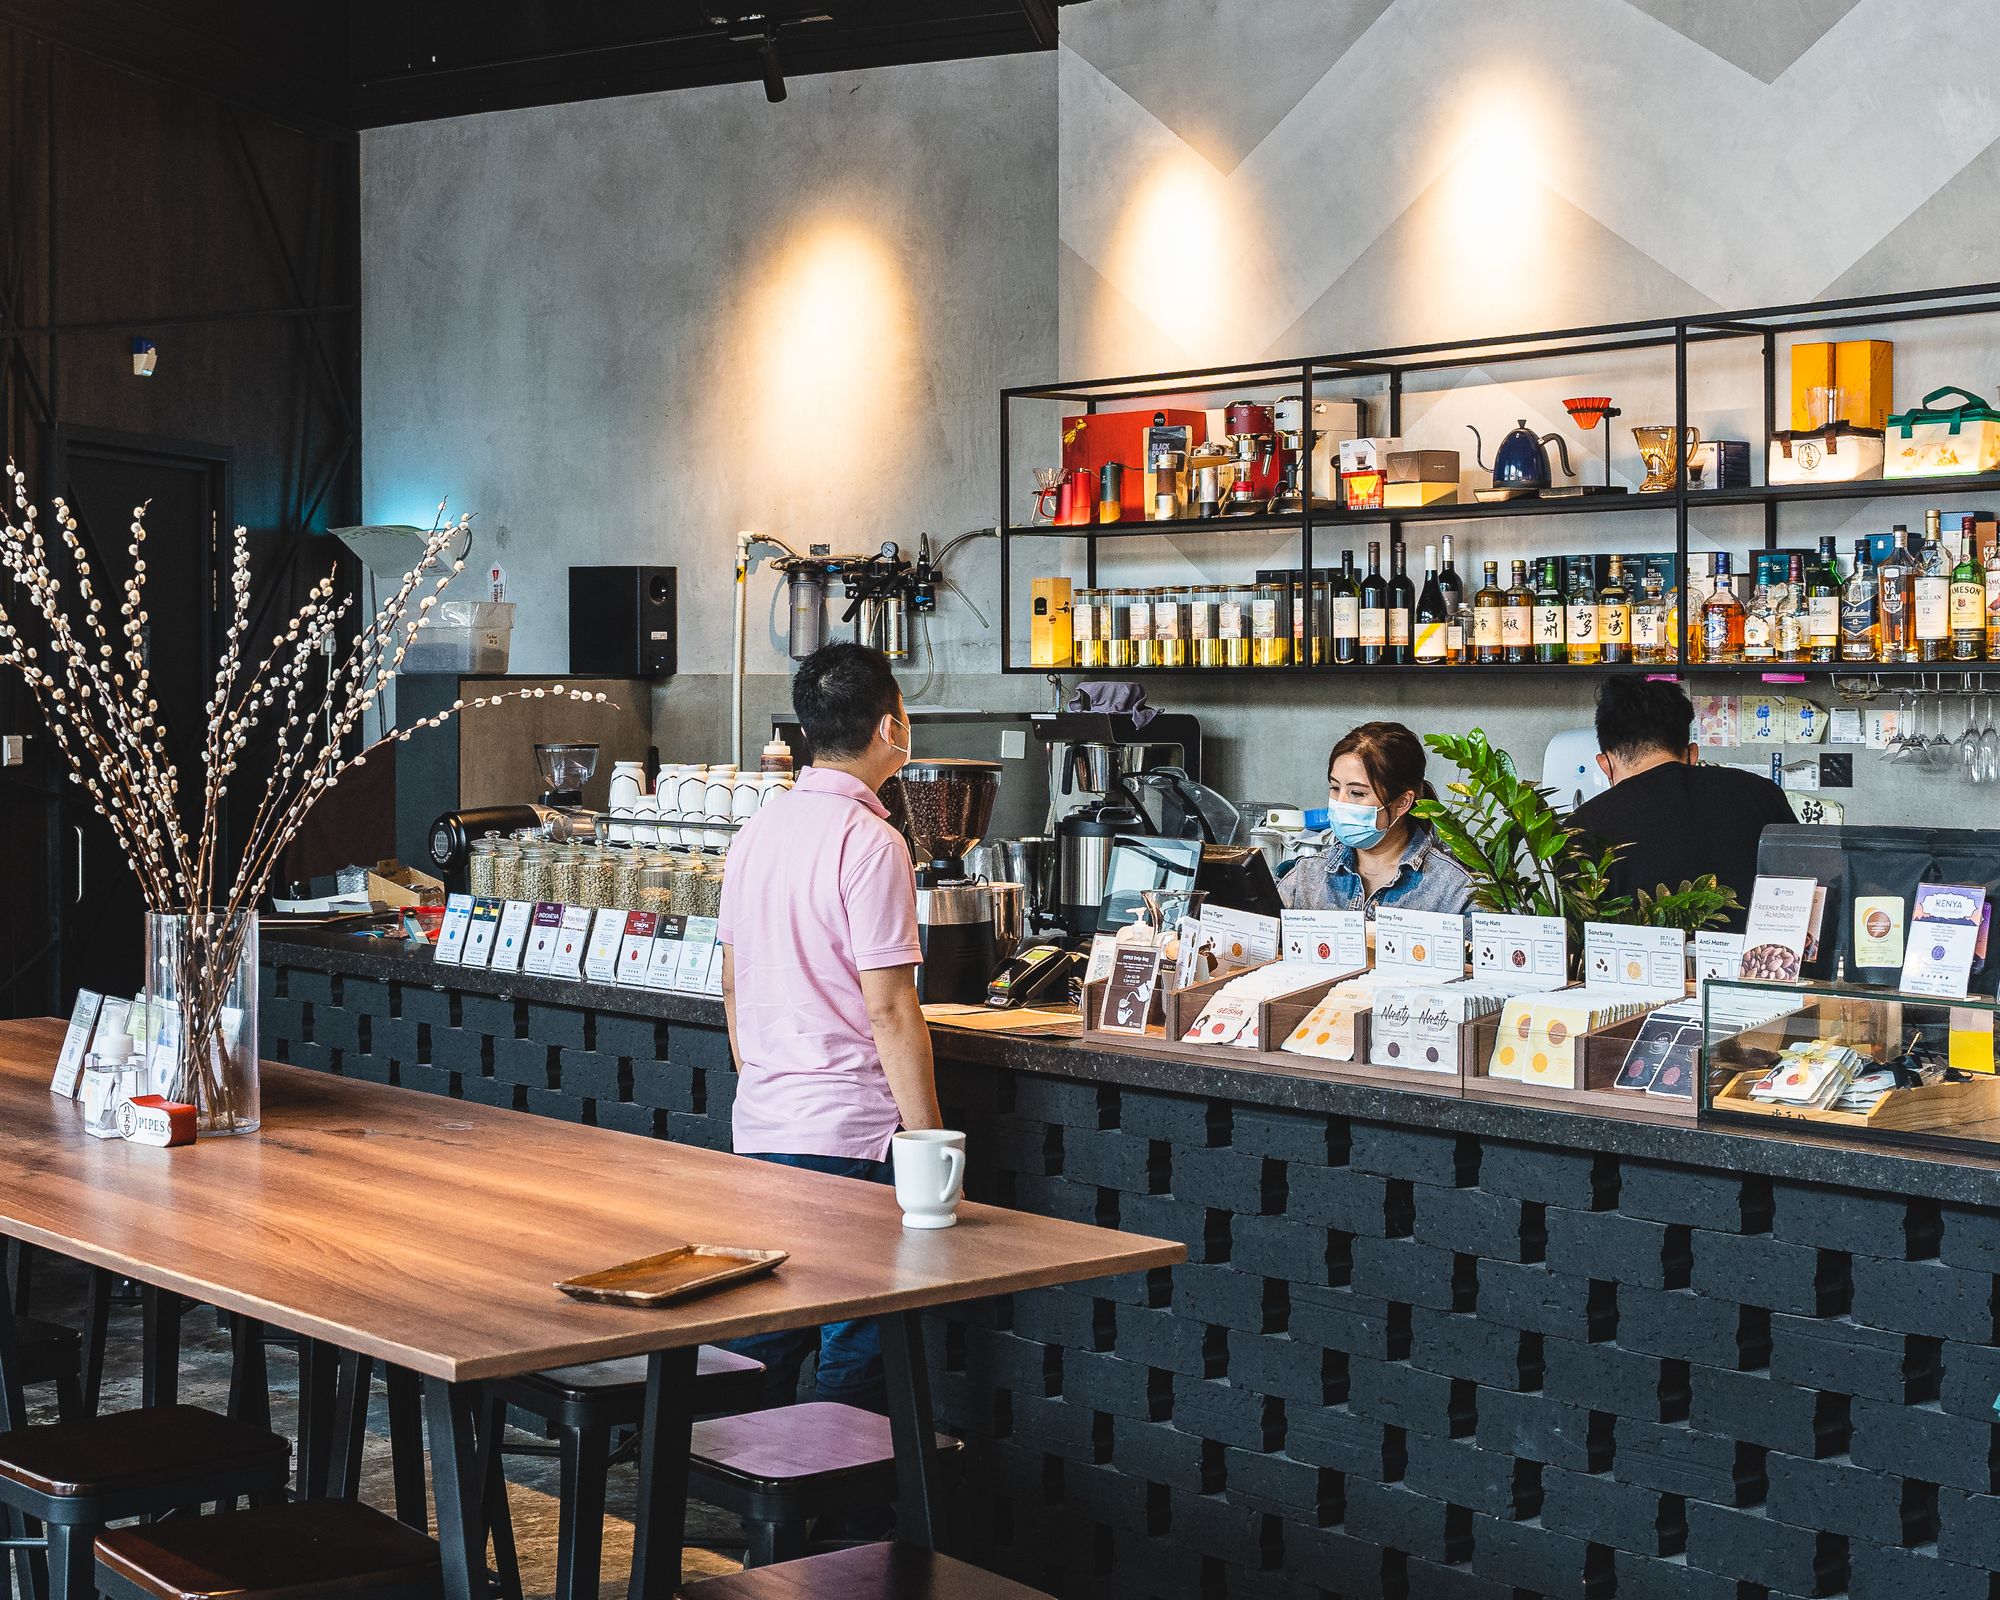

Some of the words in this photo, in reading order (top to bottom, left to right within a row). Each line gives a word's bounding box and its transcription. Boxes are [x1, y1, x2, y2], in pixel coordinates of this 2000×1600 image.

[1152, 443, 1170, 451] BLACK
[1543, 609, 1558, 639] 白州
[1576, 608, 1593, 638] 知多
[1935, 899, 1963, 909] KENYA
[1213, 911, 1224, 919] Tiger
[1378, 913, 1392, 921] Honey
[1475, 919, 1489, 927] Nasty
[1588, 928, 1614, 938] Sanctuary
[1217, 1007, 1244, 1017] GEISHA
[1380, 1003, 1410, 1027] Nasty
[1418, 1008, 1449, 1031] Nasty
[138, 1116, 166, 1133] PIPES
